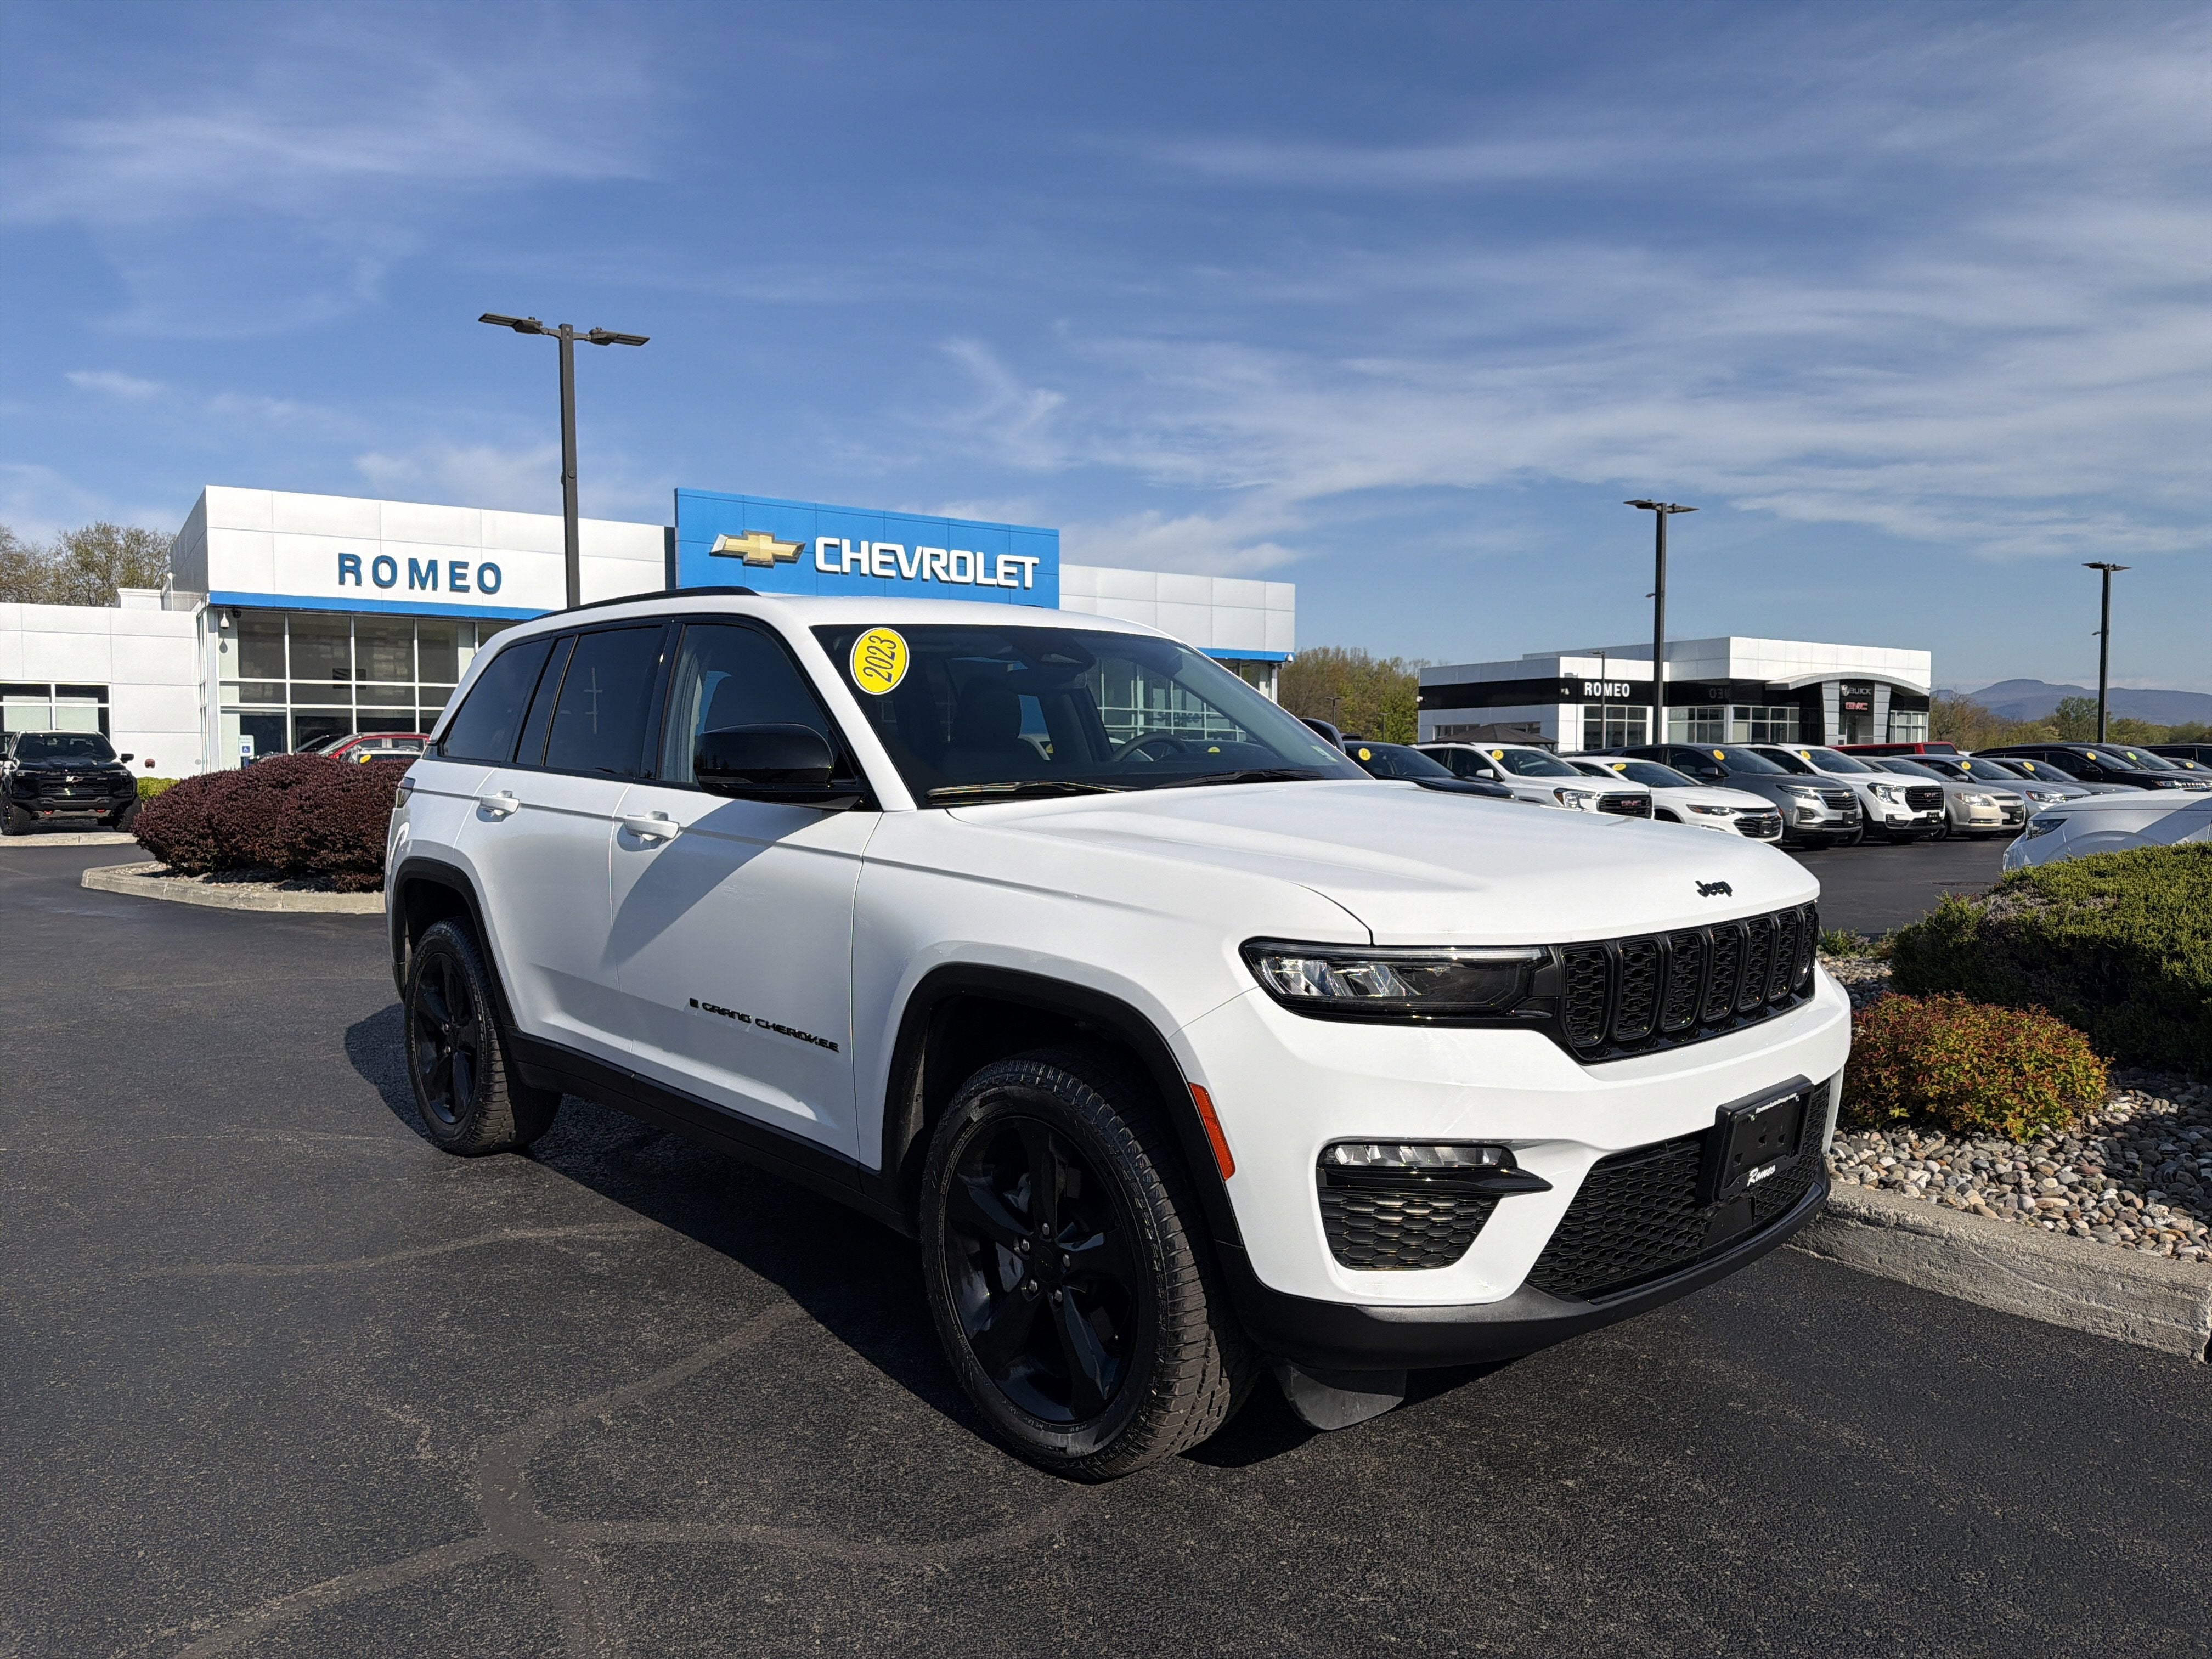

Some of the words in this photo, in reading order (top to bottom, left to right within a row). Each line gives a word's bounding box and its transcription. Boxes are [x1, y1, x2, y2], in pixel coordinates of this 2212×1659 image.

[338, 552, 502, 595] ROMEO
[815, 537, 1040, 589] CHEVROLET
[863, 635, 897, 684] 2023
[1584, 682, 1630, 697] ROMEO
[1845, 702, 1869, 710] GMC
[1695, 880, 1733, 897] Jeep
[702, 1002, 752, 1023] GRAND
[755, 1018, 840, 1053] CHEROKEE
[1747, 1164, 1776, 1187] Romeo
